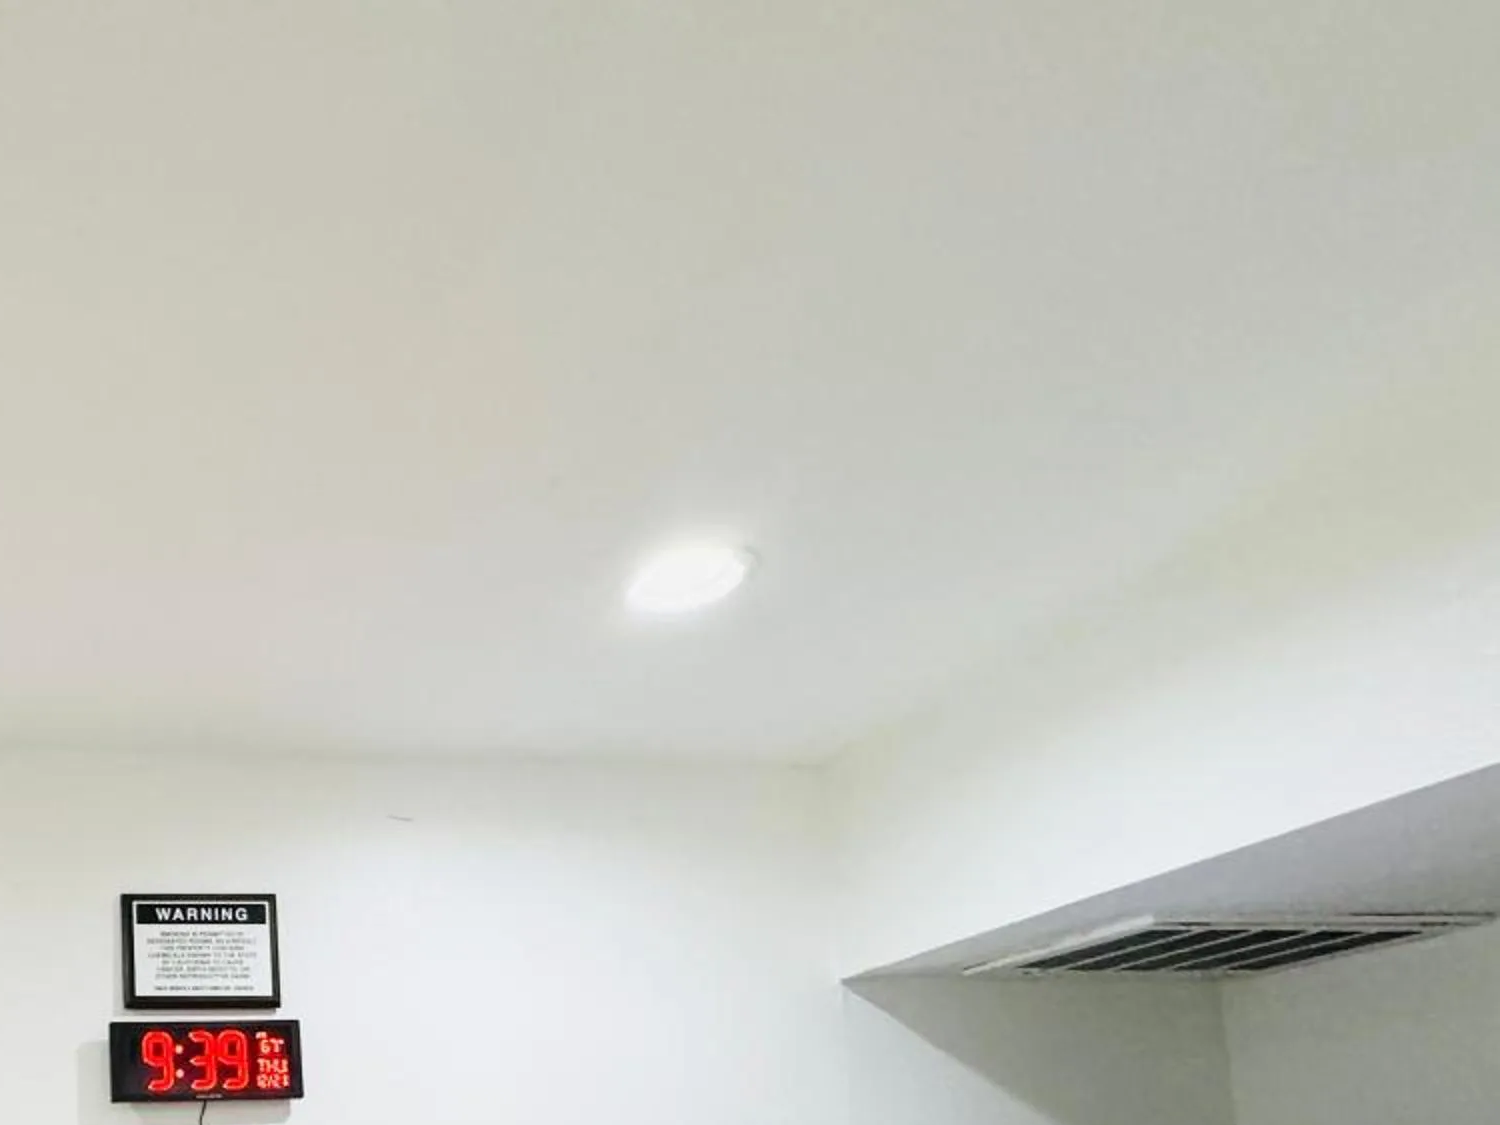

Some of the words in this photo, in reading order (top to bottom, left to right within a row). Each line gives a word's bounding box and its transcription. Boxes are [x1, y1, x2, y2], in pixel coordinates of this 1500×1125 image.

[155, 907, 249, 921] WARNING
[142, 1030, 249, 1091] 9:39
[257, 1058, 289, 1073] THU
